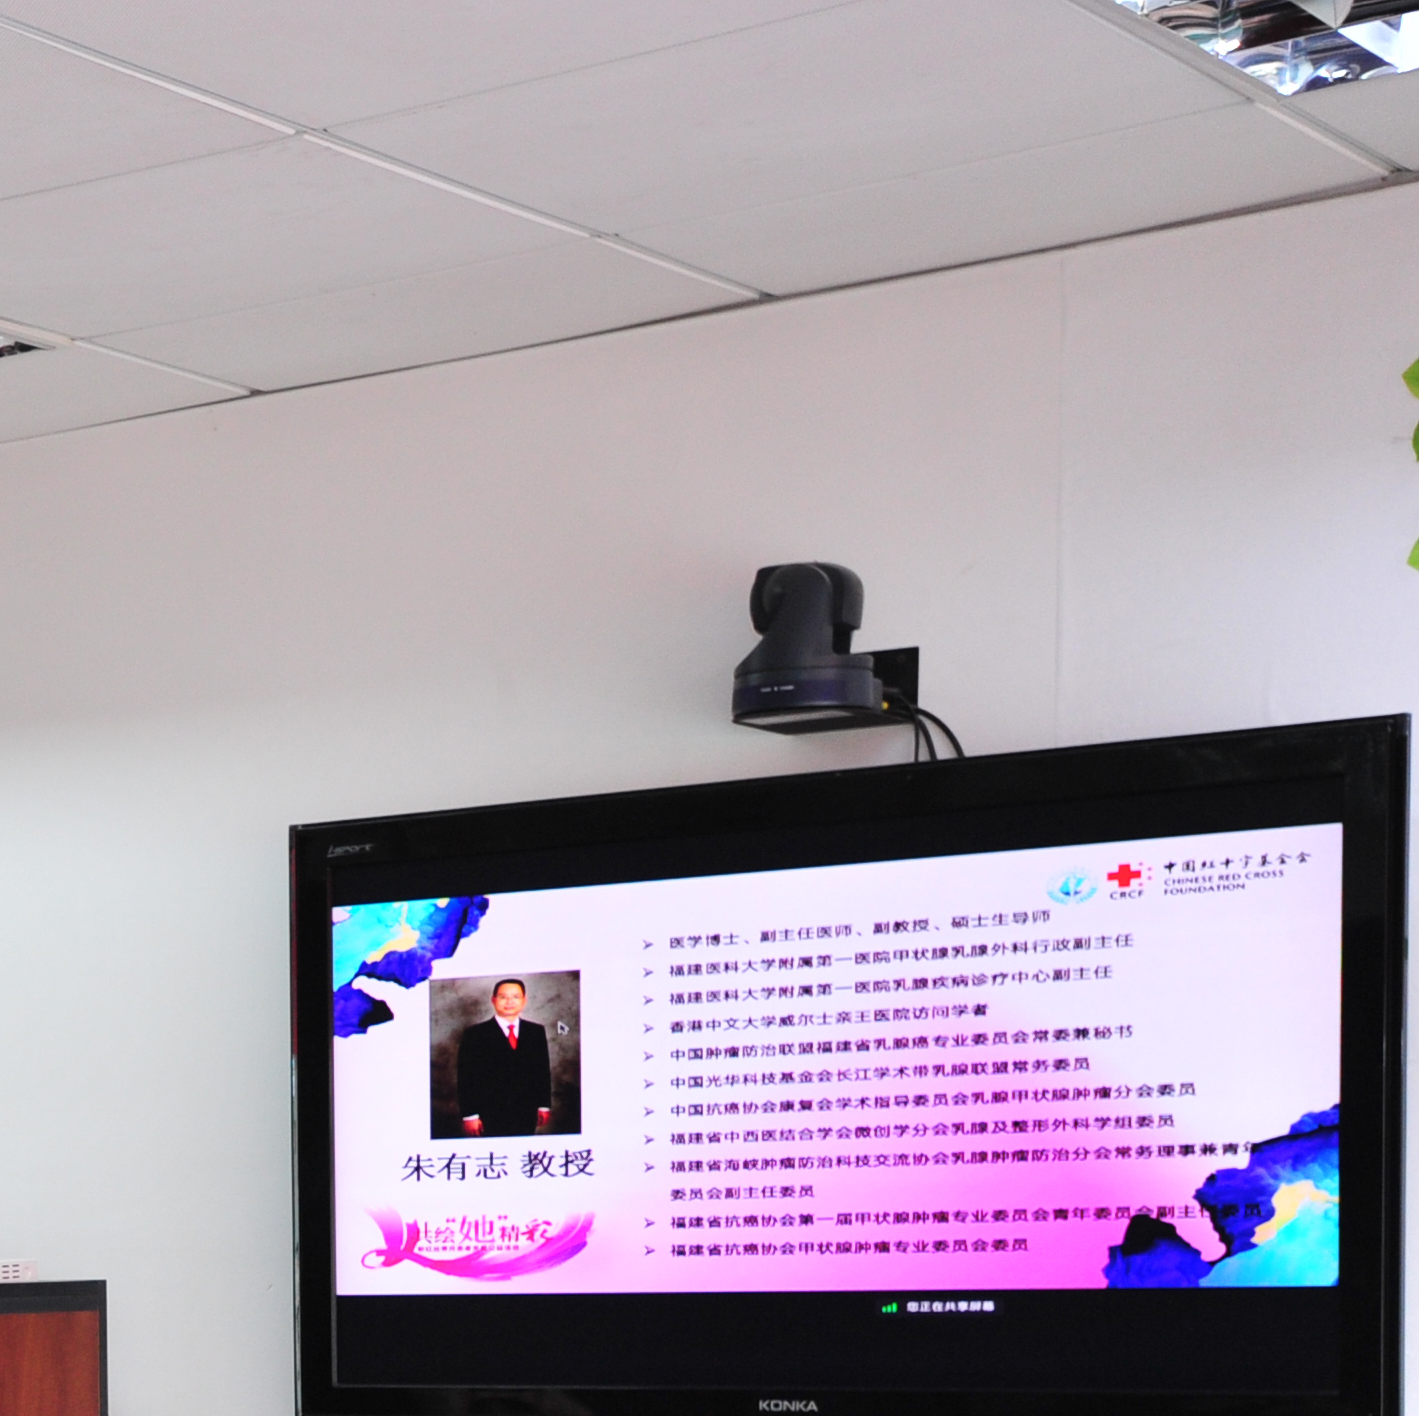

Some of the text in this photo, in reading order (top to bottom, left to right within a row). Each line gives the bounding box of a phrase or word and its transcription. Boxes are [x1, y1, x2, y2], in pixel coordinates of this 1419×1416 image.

[1164, 869, 1285, 886] CHINESE RED CROSS
[1164, 882, 1246, 896] FOUNDATION
[401, 1148, 596, 1182] 朱有志 教授
[670, 1184, 815, 1201] 委员会副主任委员
[758, 1399, 819, 1412] KONKA
